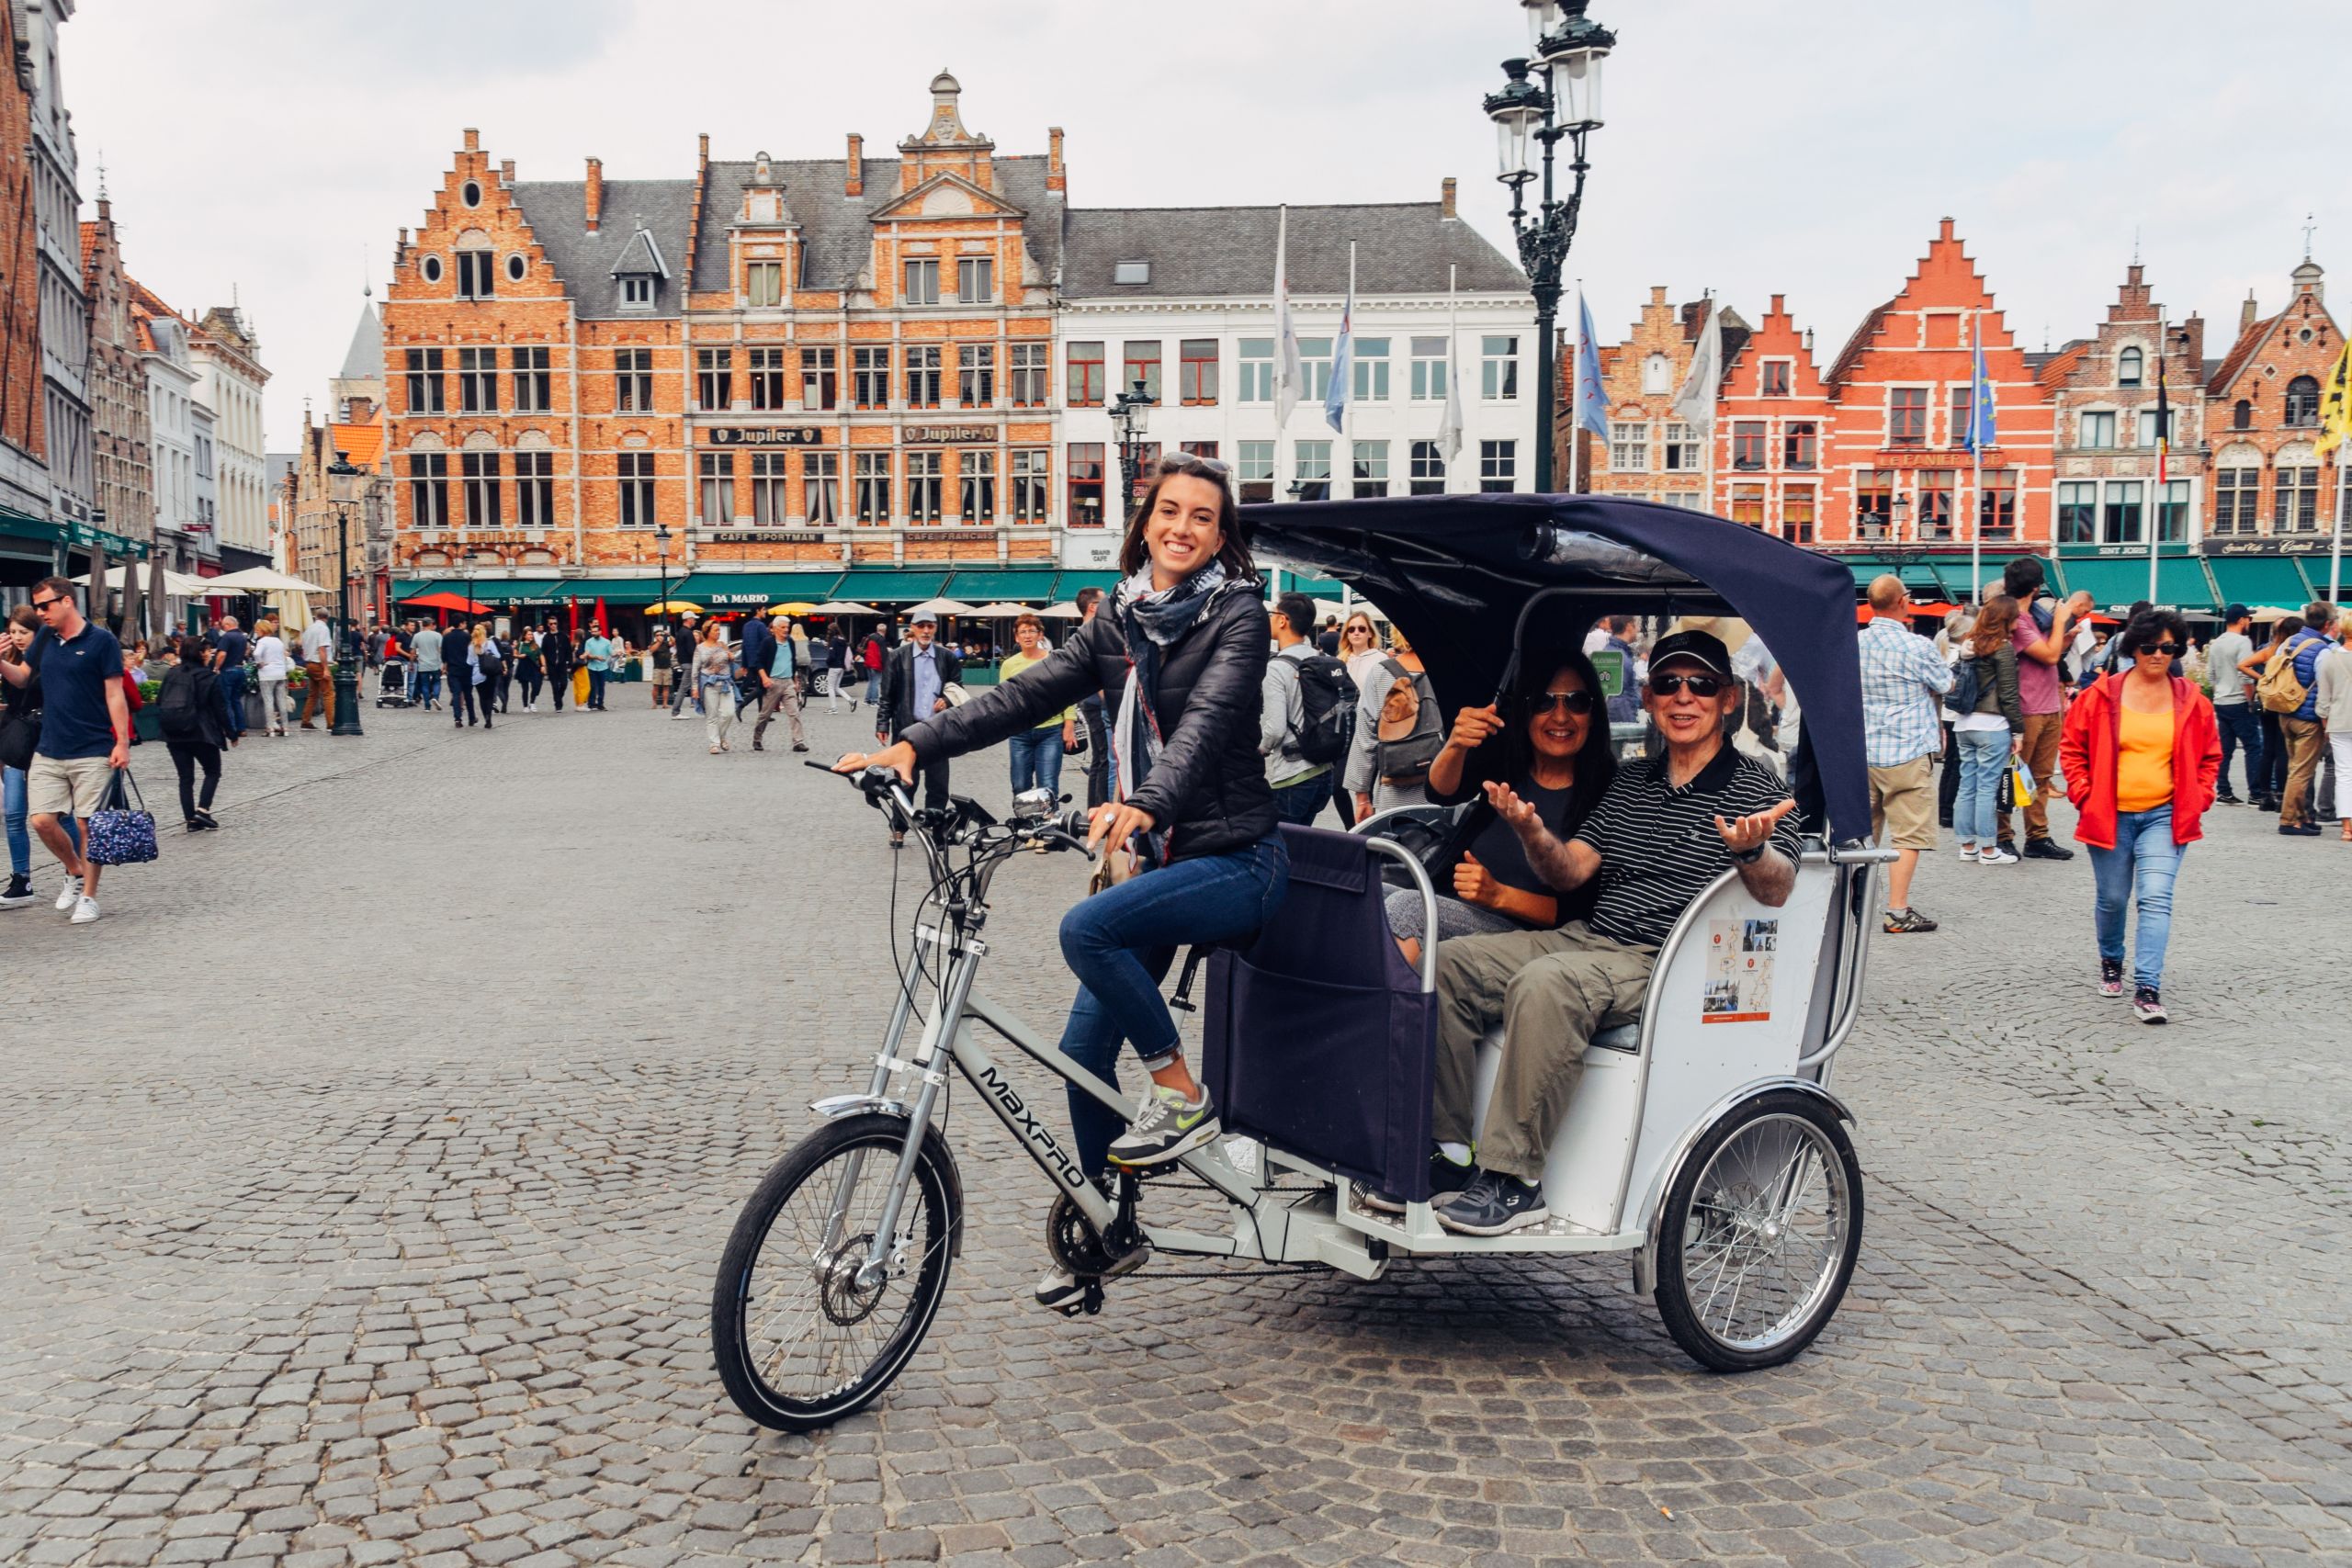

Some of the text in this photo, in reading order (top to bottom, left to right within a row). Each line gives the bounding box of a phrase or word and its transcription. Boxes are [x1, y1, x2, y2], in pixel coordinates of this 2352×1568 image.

[736, 428, 796, 445] Jupiler
[922, 426, 980, 443] Jupiler
[1904, 454, 1959, 467] PANIER
[438, 532, 526, 543] DE BEURZE
[524, 597, 553, 605] Beurze
[712, 594, 769, 604] DA MARIO
